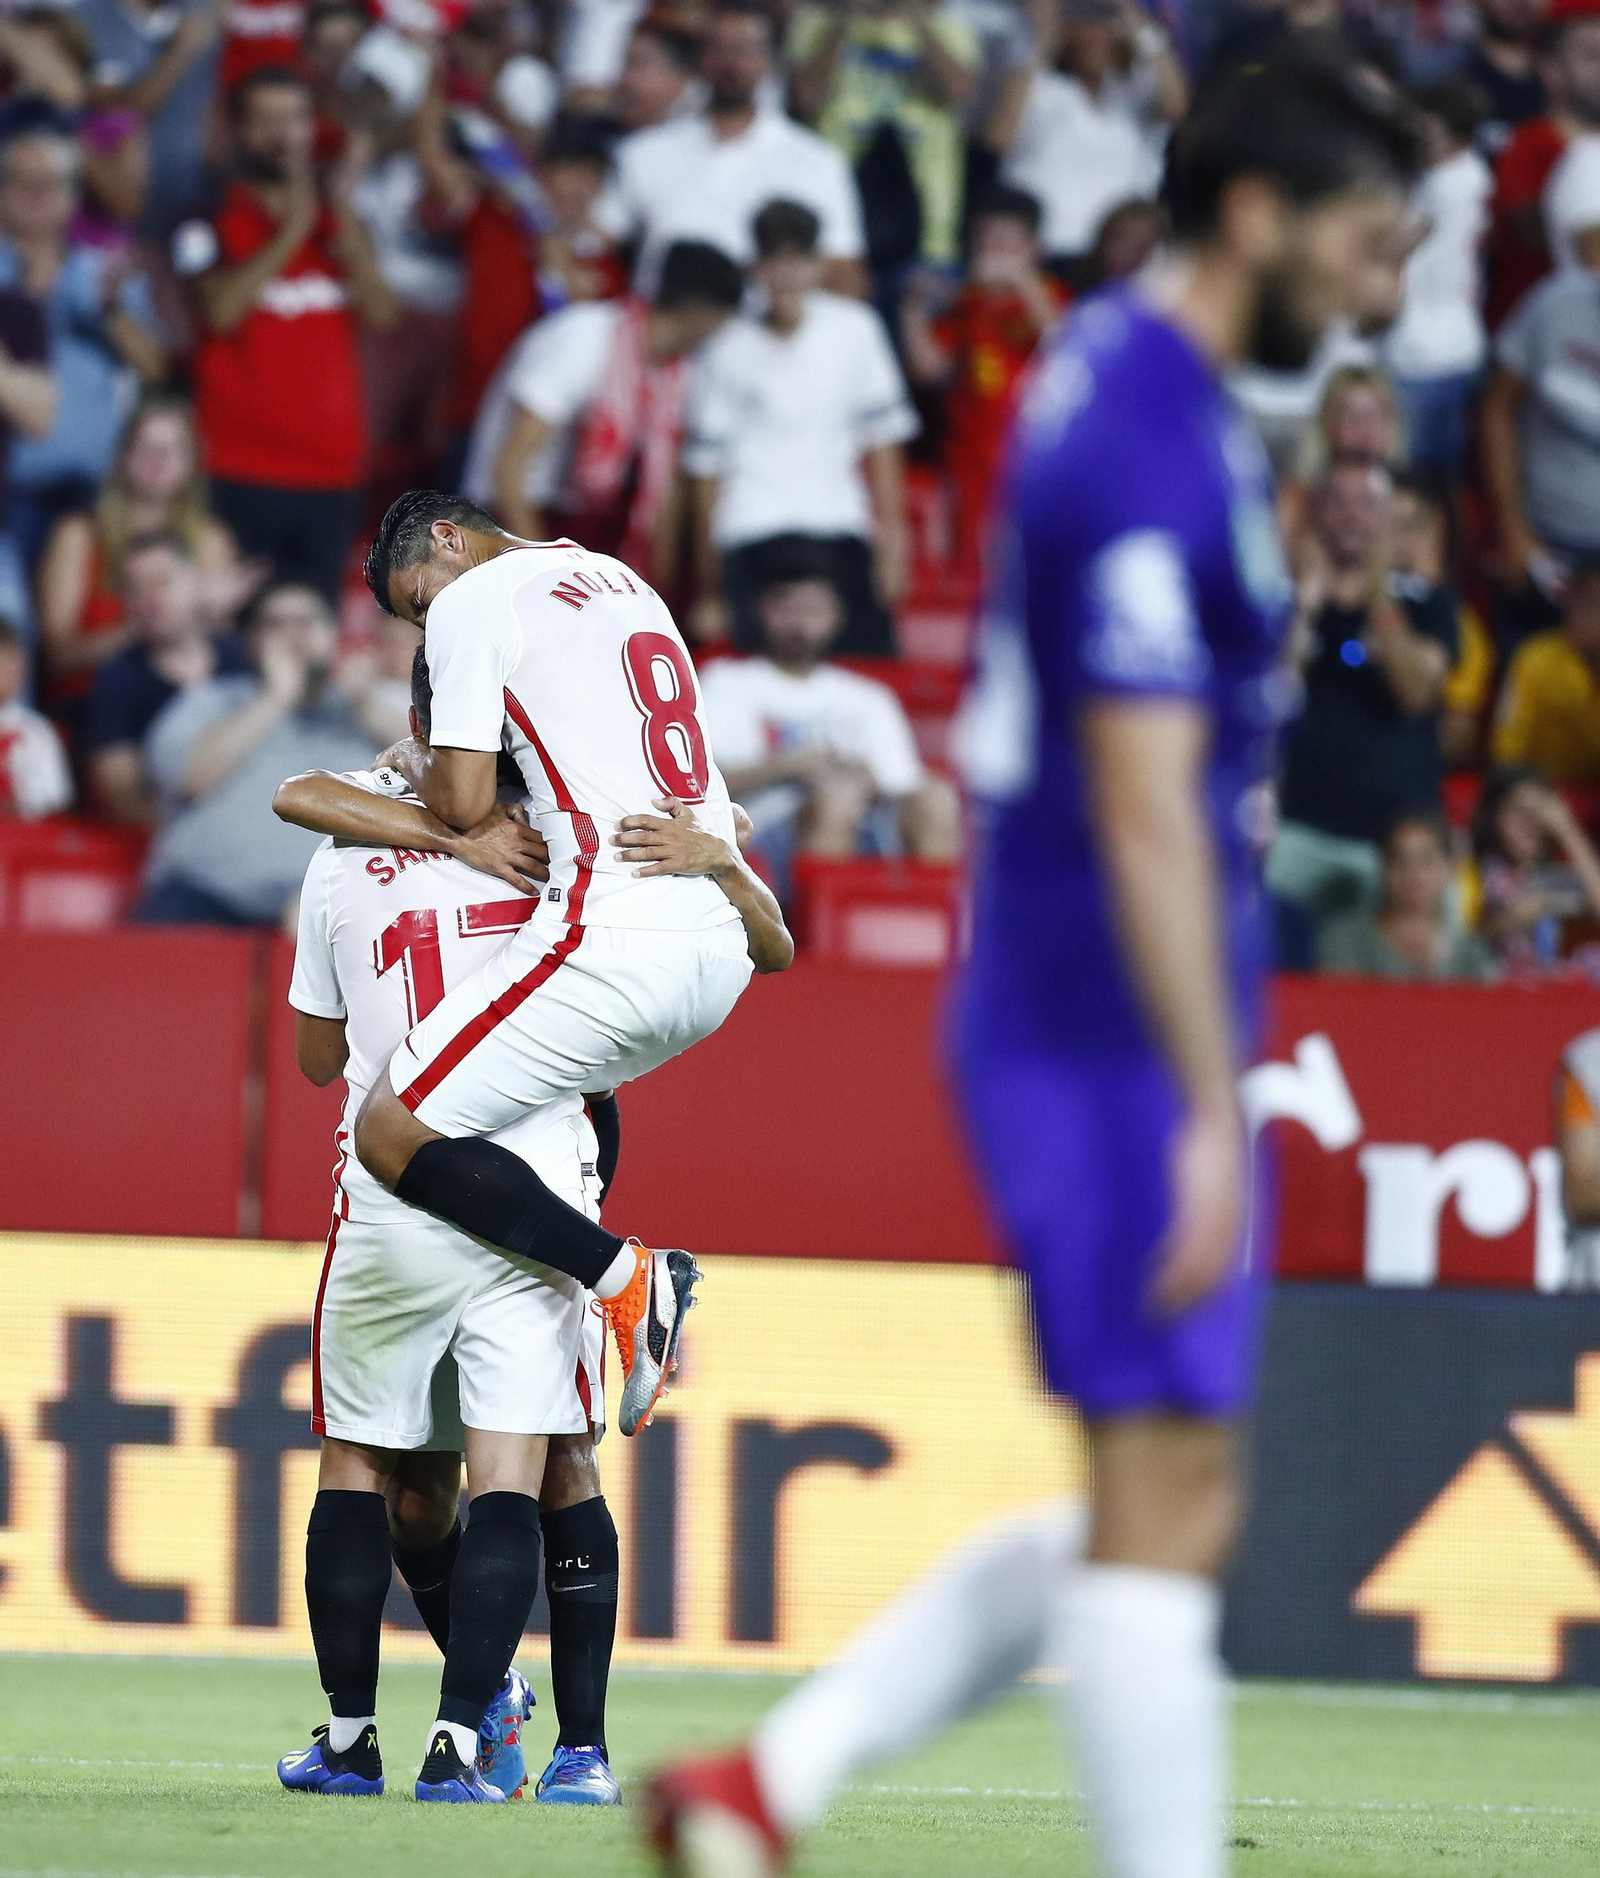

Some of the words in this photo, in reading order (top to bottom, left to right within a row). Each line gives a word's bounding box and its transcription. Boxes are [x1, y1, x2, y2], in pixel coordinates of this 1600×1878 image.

[621, 632, 709, 805] 8
[365, 845, 453, 886] SA
[0, 1312, 894, 1641] tfir
